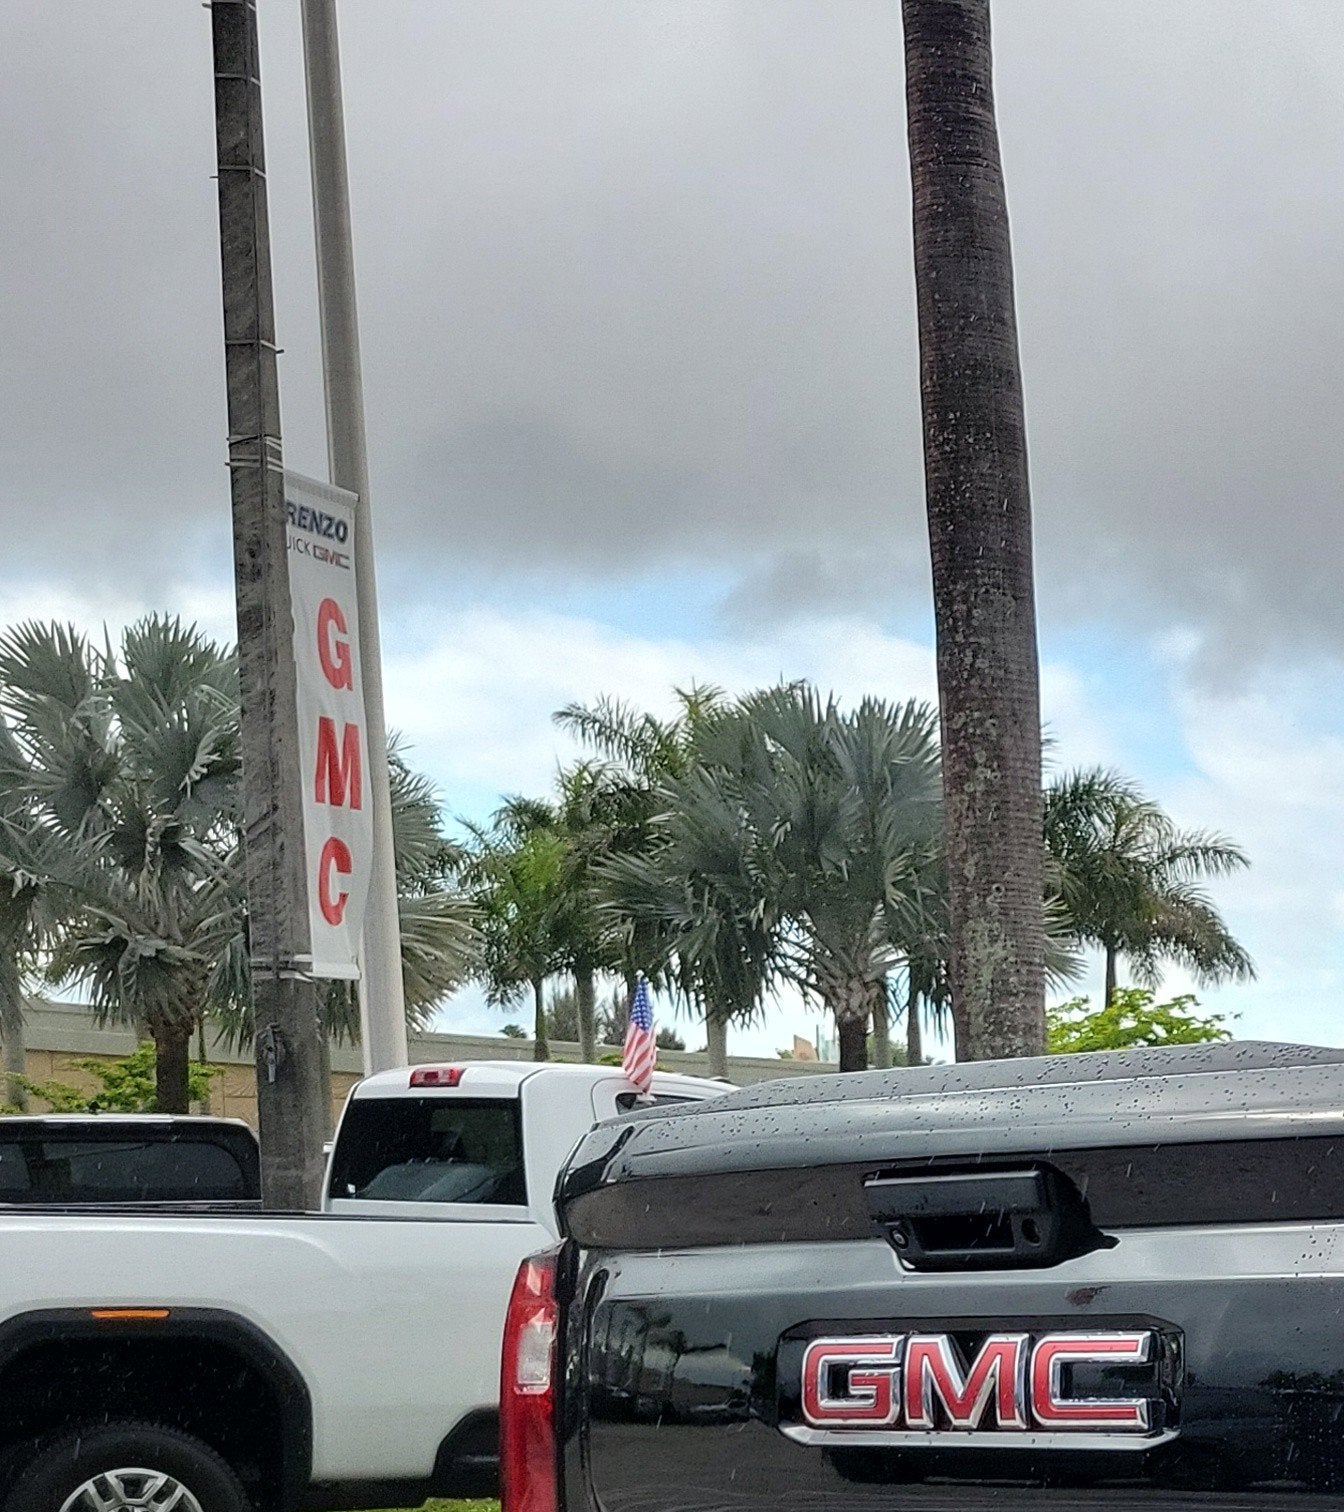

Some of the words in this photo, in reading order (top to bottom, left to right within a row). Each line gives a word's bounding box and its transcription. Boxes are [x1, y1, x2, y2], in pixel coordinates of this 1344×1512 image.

[285, 501, 349, 544] RENZO
[286, 535, 311, 556] UICK
[314, 597, 362, 927] GMC
[801, 1330, 1152, 1431] GMC
